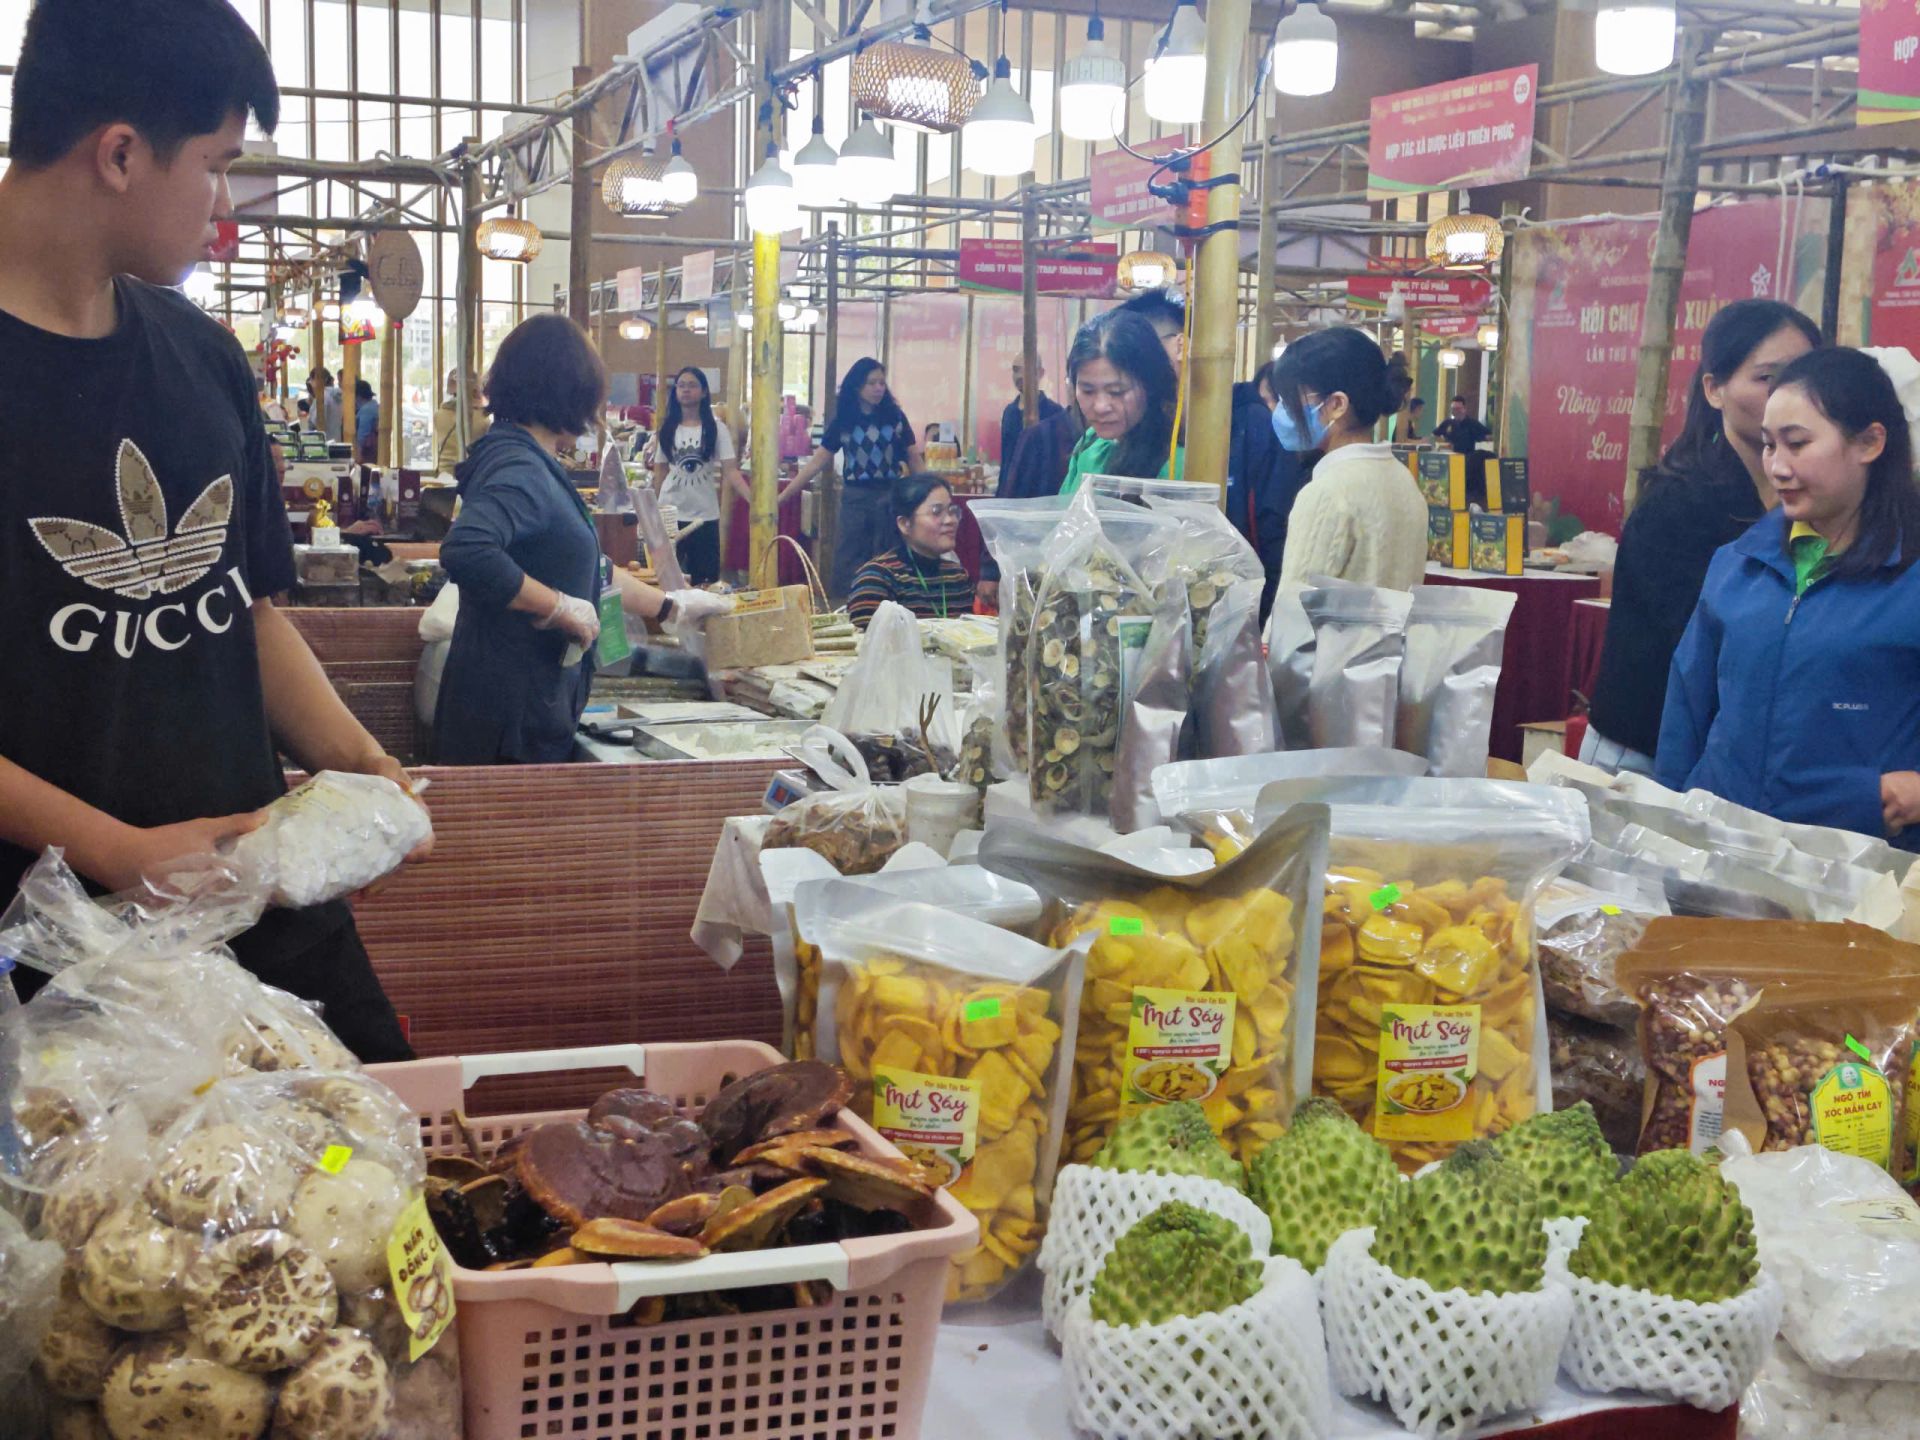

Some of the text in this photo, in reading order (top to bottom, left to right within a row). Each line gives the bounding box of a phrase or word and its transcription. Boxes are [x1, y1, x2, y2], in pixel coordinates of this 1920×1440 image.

[1894, 36, 1918, 64] HỢP
[1580, 299, 1604, 339] HỘI
[1557, 385, 1600, 425] Nông
[1587, 431, 1623, 460] Lan
[49, 566, 253, 659] GUCCI
[1833, 1091, 1854, 1104] NGÔ
[1866, 1101, 1883, 1112] CAY
